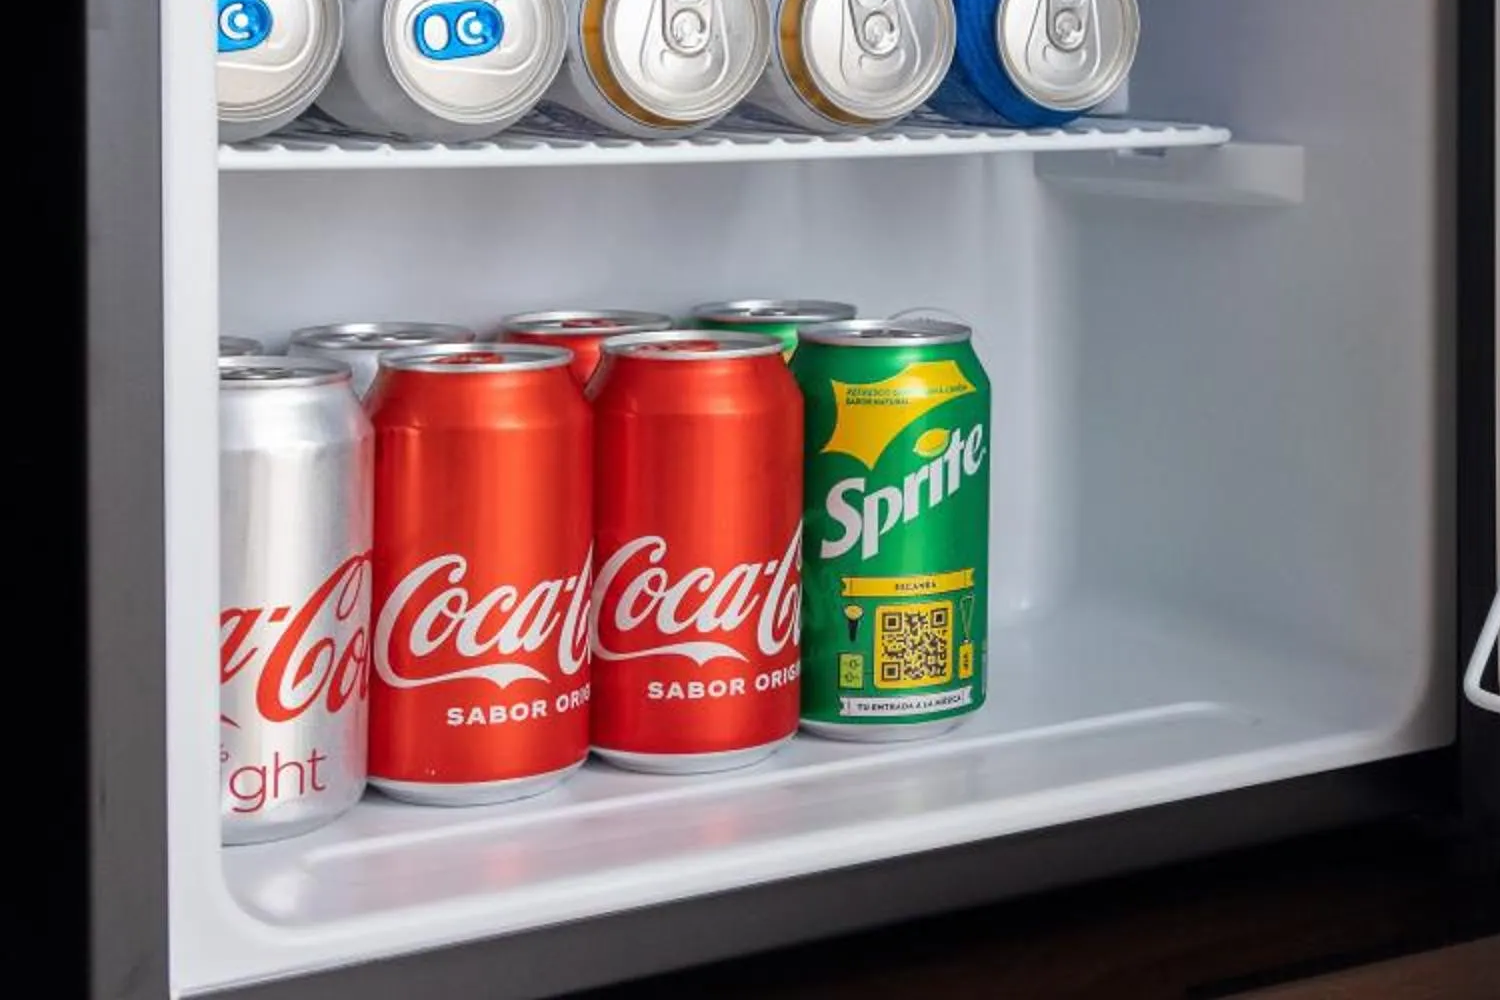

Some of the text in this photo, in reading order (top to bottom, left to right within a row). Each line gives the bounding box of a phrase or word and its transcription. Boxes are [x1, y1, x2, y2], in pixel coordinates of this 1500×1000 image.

[820, 424, 987, 561] Sprite
[648, 678, 746, 700] SABOR
[447, 699, 547, 726] SABOR
[229, 748, 328, 813] ght
